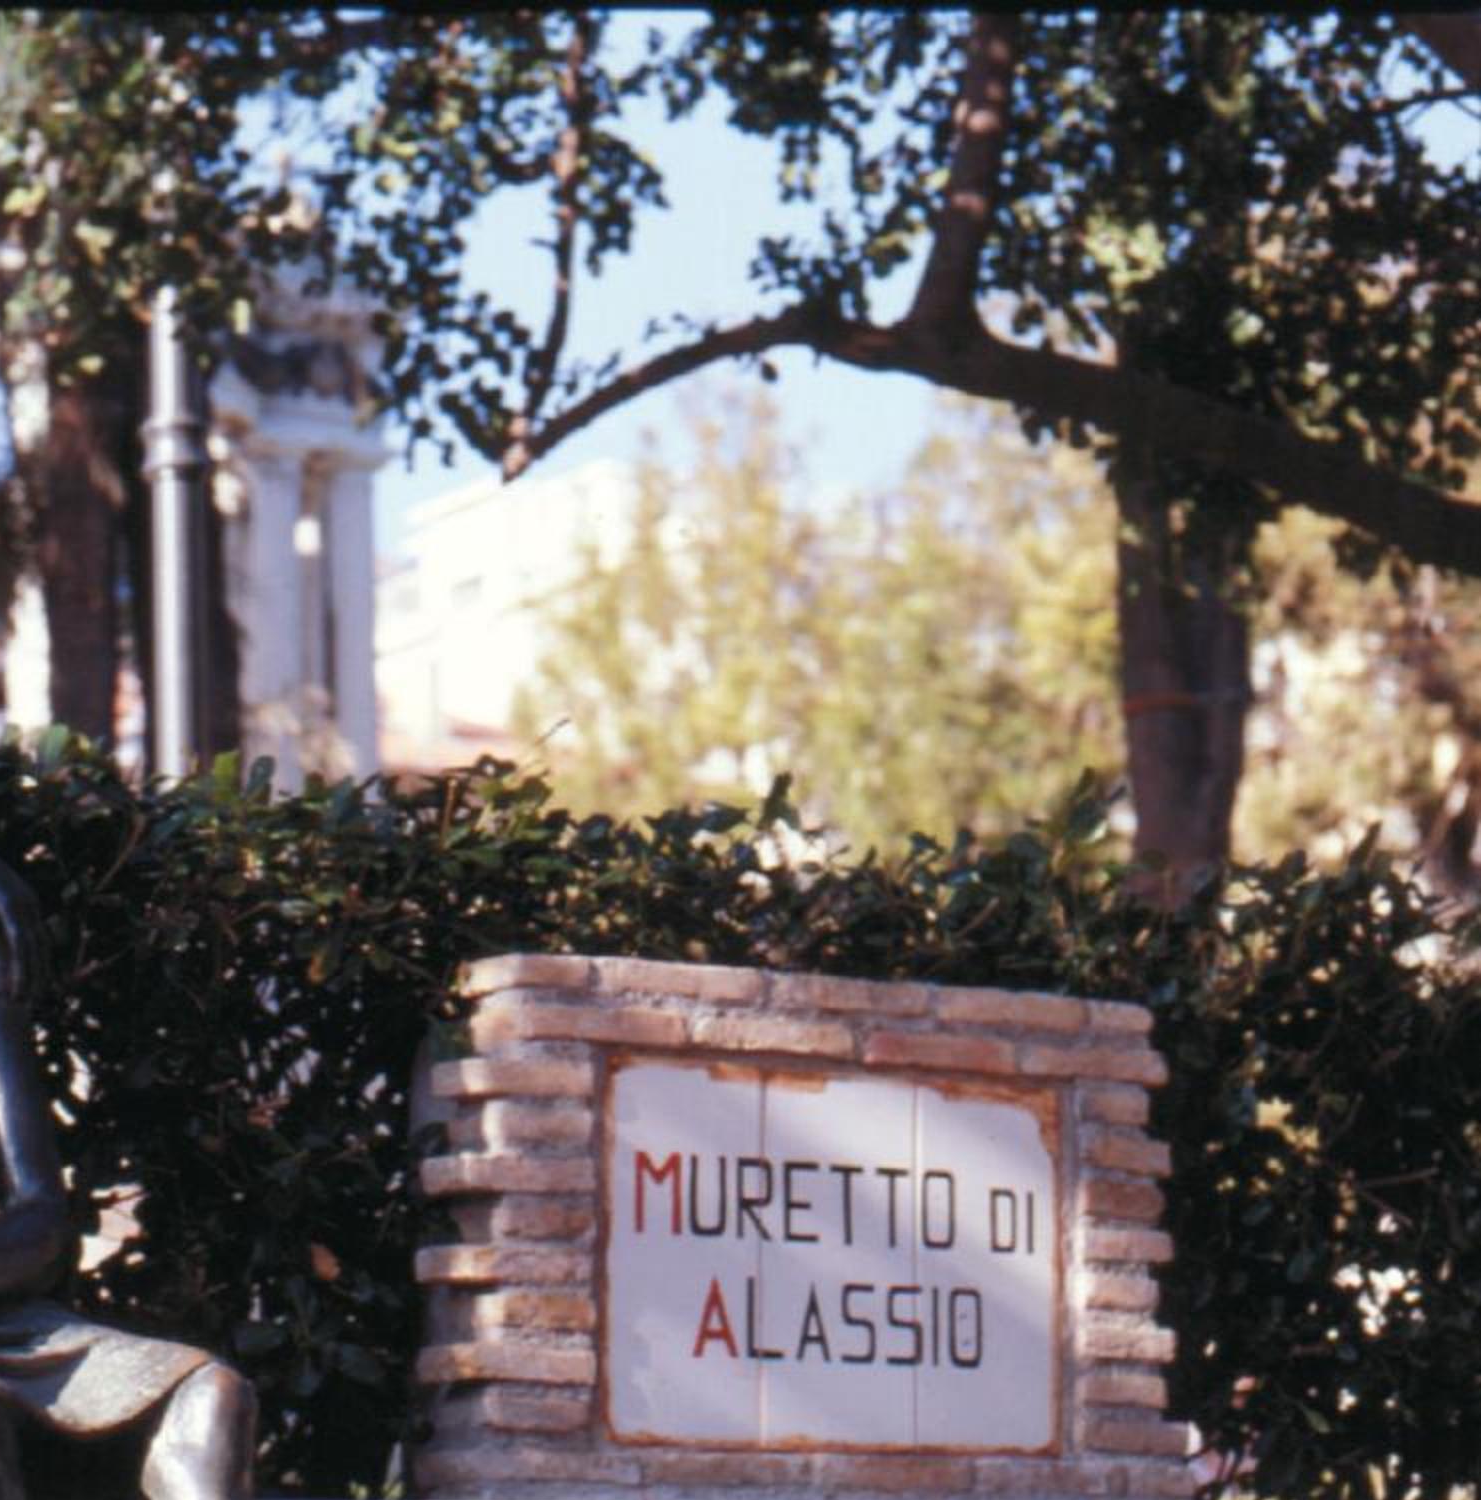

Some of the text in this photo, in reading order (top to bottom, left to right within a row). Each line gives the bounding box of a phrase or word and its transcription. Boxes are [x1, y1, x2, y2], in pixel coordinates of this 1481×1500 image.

[633, 1150, 1035, 1255] MURETTO DI
[691, 1275, 984, 1369] ALASSIO
